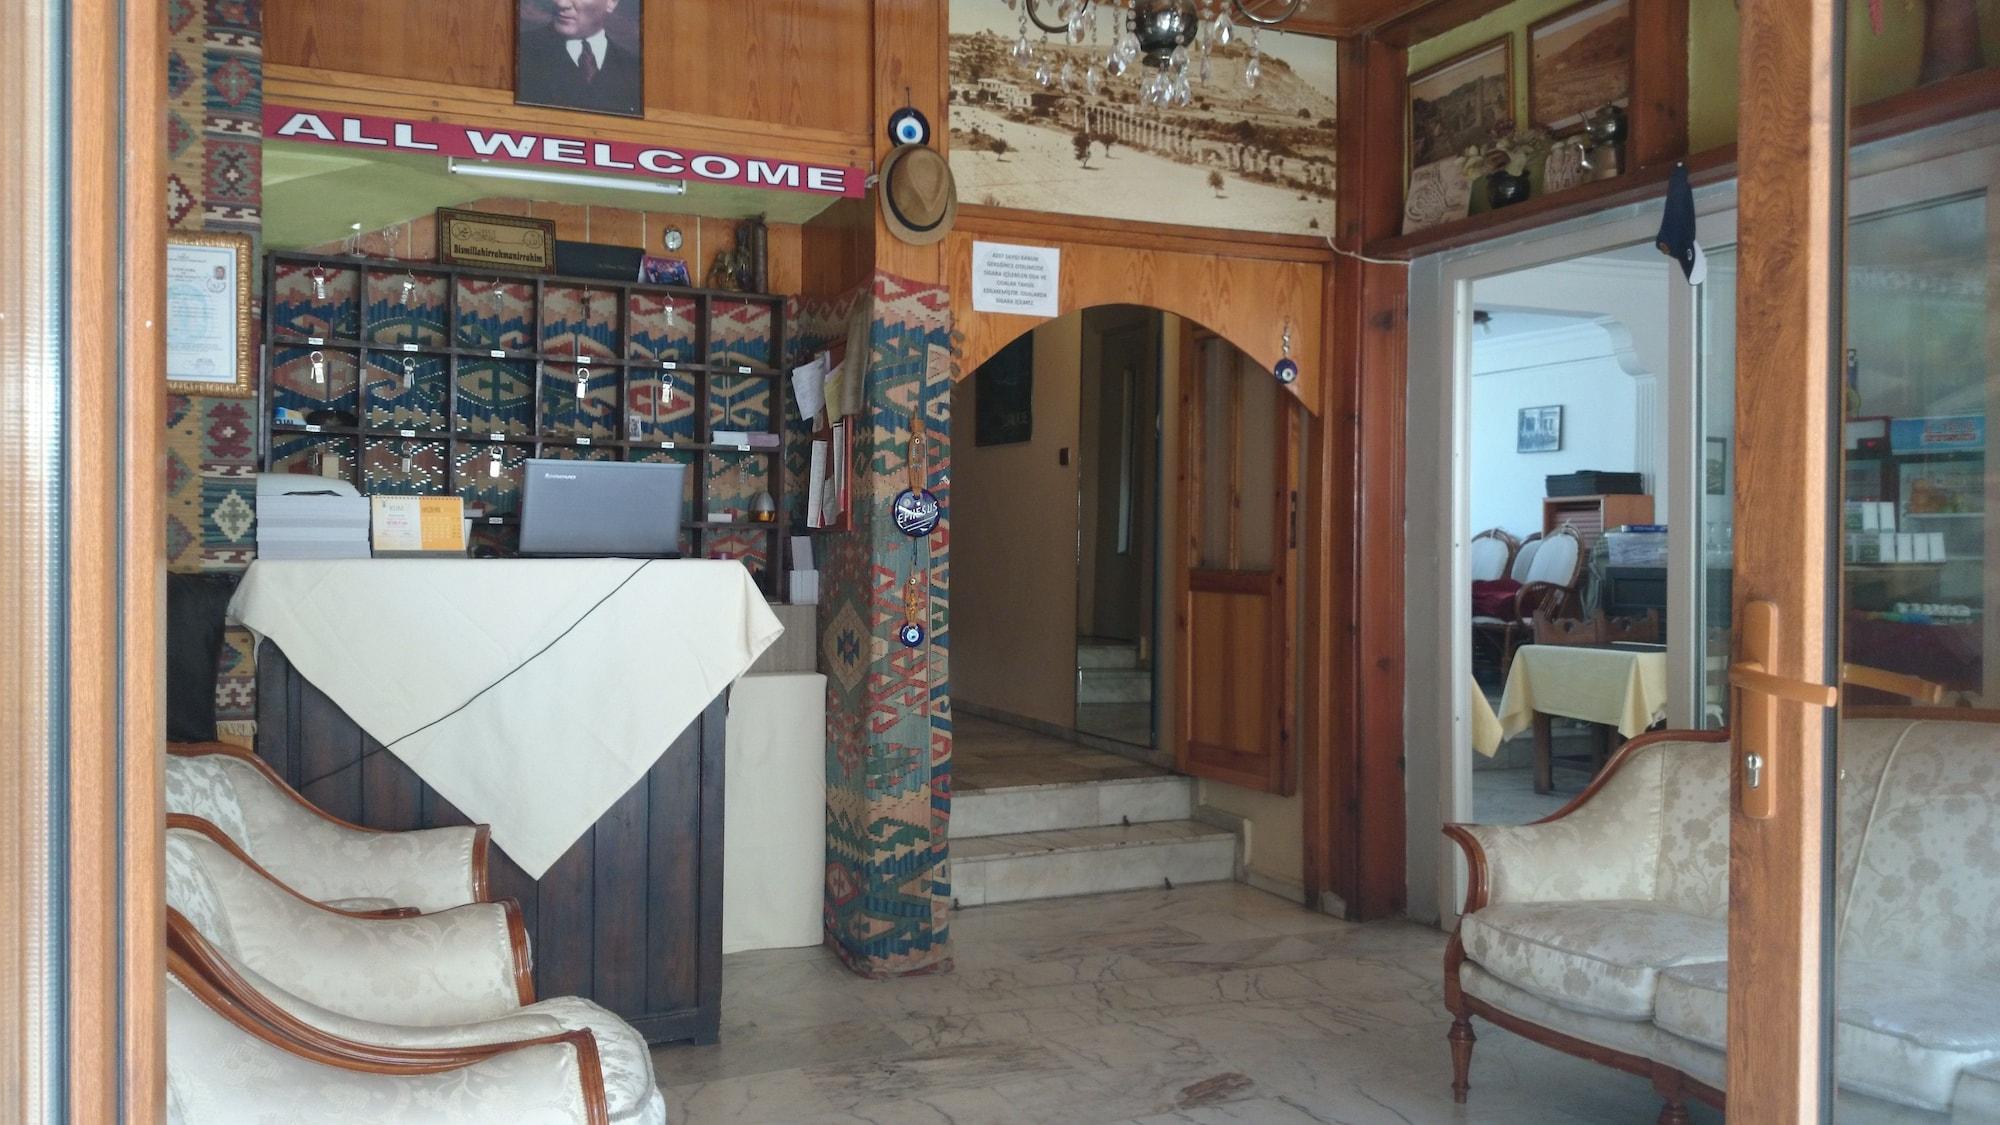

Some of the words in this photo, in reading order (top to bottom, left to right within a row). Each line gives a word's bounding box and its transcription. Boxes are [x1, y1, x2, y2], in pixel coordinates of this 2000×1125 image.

[277, 113, 439, 151] ALL
[465, 129, 847, 192] WELCOME
[897, 501, 938, 524] EPHESUS
